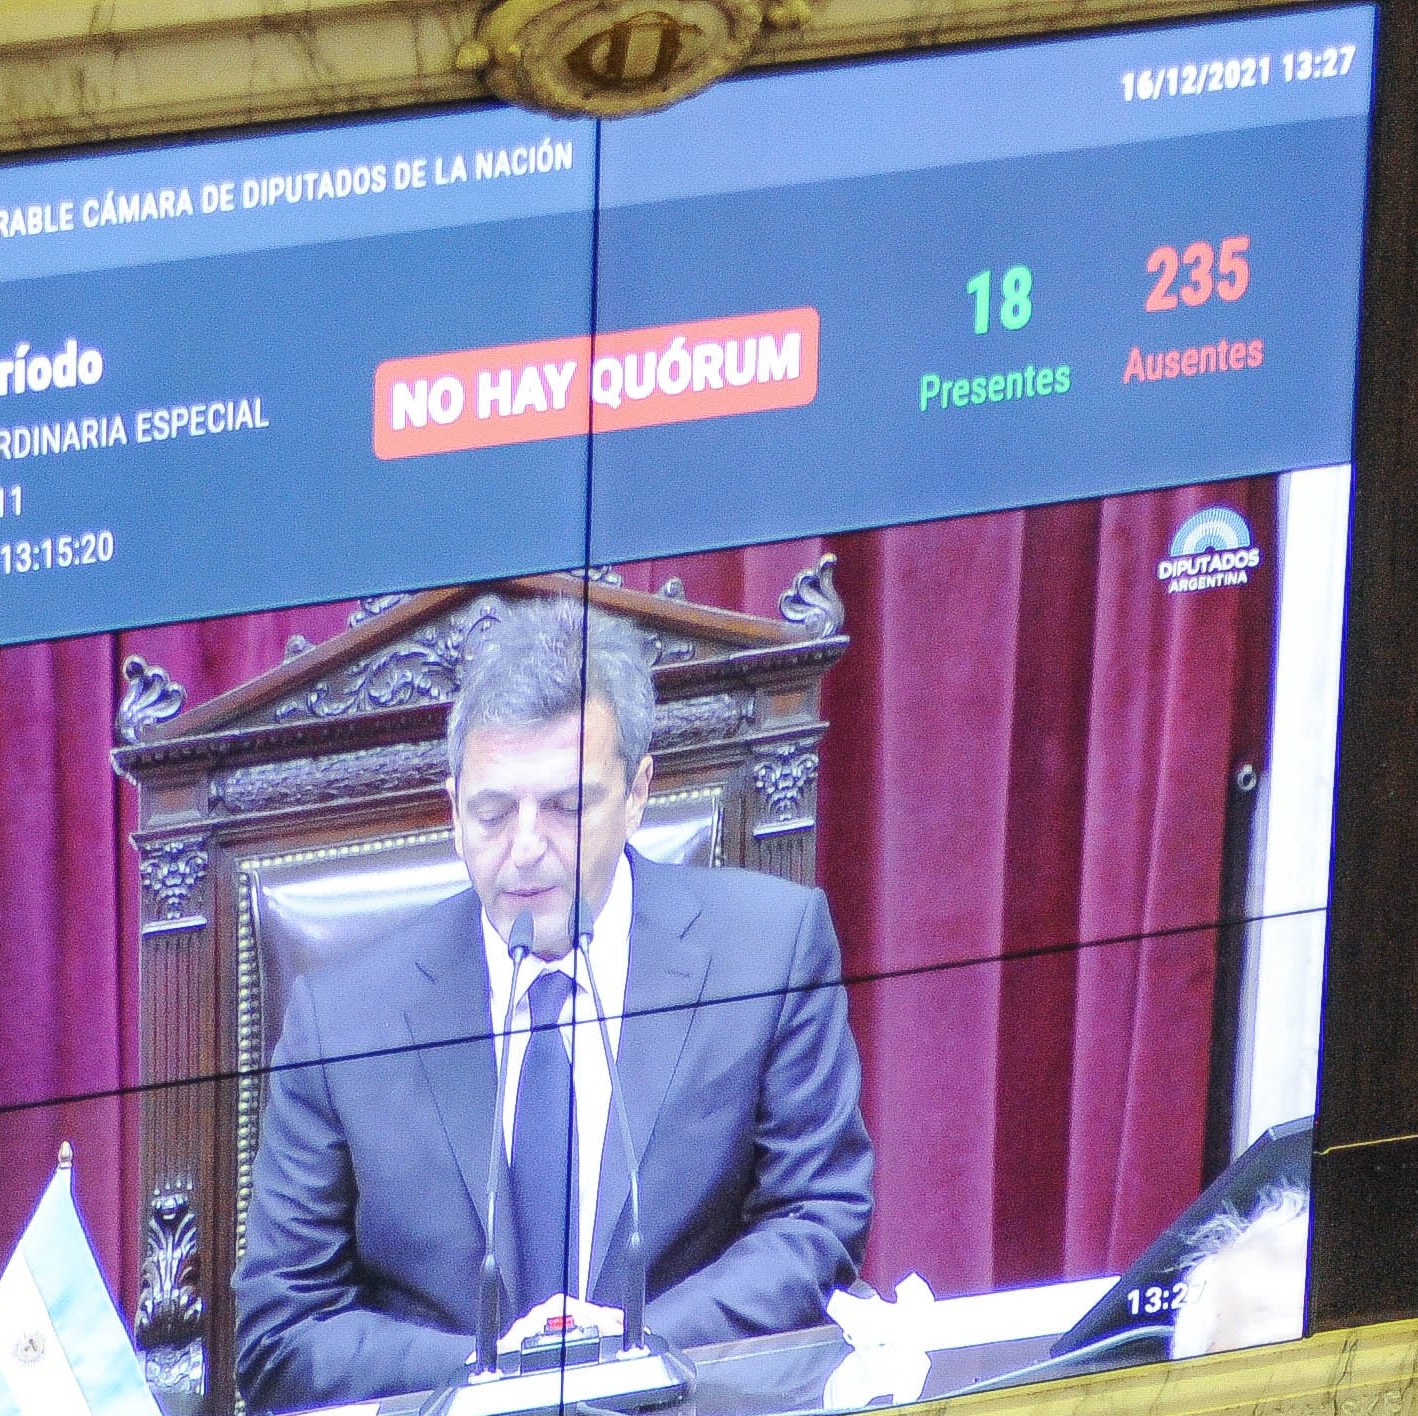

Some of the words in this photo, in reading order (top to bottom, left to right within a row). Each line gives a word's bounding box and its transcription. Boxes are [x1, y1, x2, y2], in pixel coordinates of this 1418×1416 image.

[1121, 56, 1271, 102] 16/12/2021
[1282, 44, 1356, 82] 13:27
[82, 184, 192, 227] CÁMARA
[201, 182, 234, 213] DE
[242, 164, 385, 209] DIPUTADOS
[393, 159, 426, 190] DE
[435, 154, 467, 185] LA
[475, 138, 573, 179] NACIÓN
[1144, 235, 1250, 312] 235
[966, 264, 1033, 335] 18
[390, 375, 465, 431] NO
[475, 361, 577, 419] HAY
[591, 331, 801, 405] QUÓRUM
[1123, 338, 1264, 384] Ausentes
[920, 363, 1071, 411] Presentes
[136, 397, 269, 444] ESPECIAL
[0, 530, 114, 574] 13:15:20
[1158, 549, 1259, 583] DIPUTADOS
[1169, 569, 1247, 594] ARGENTINA
